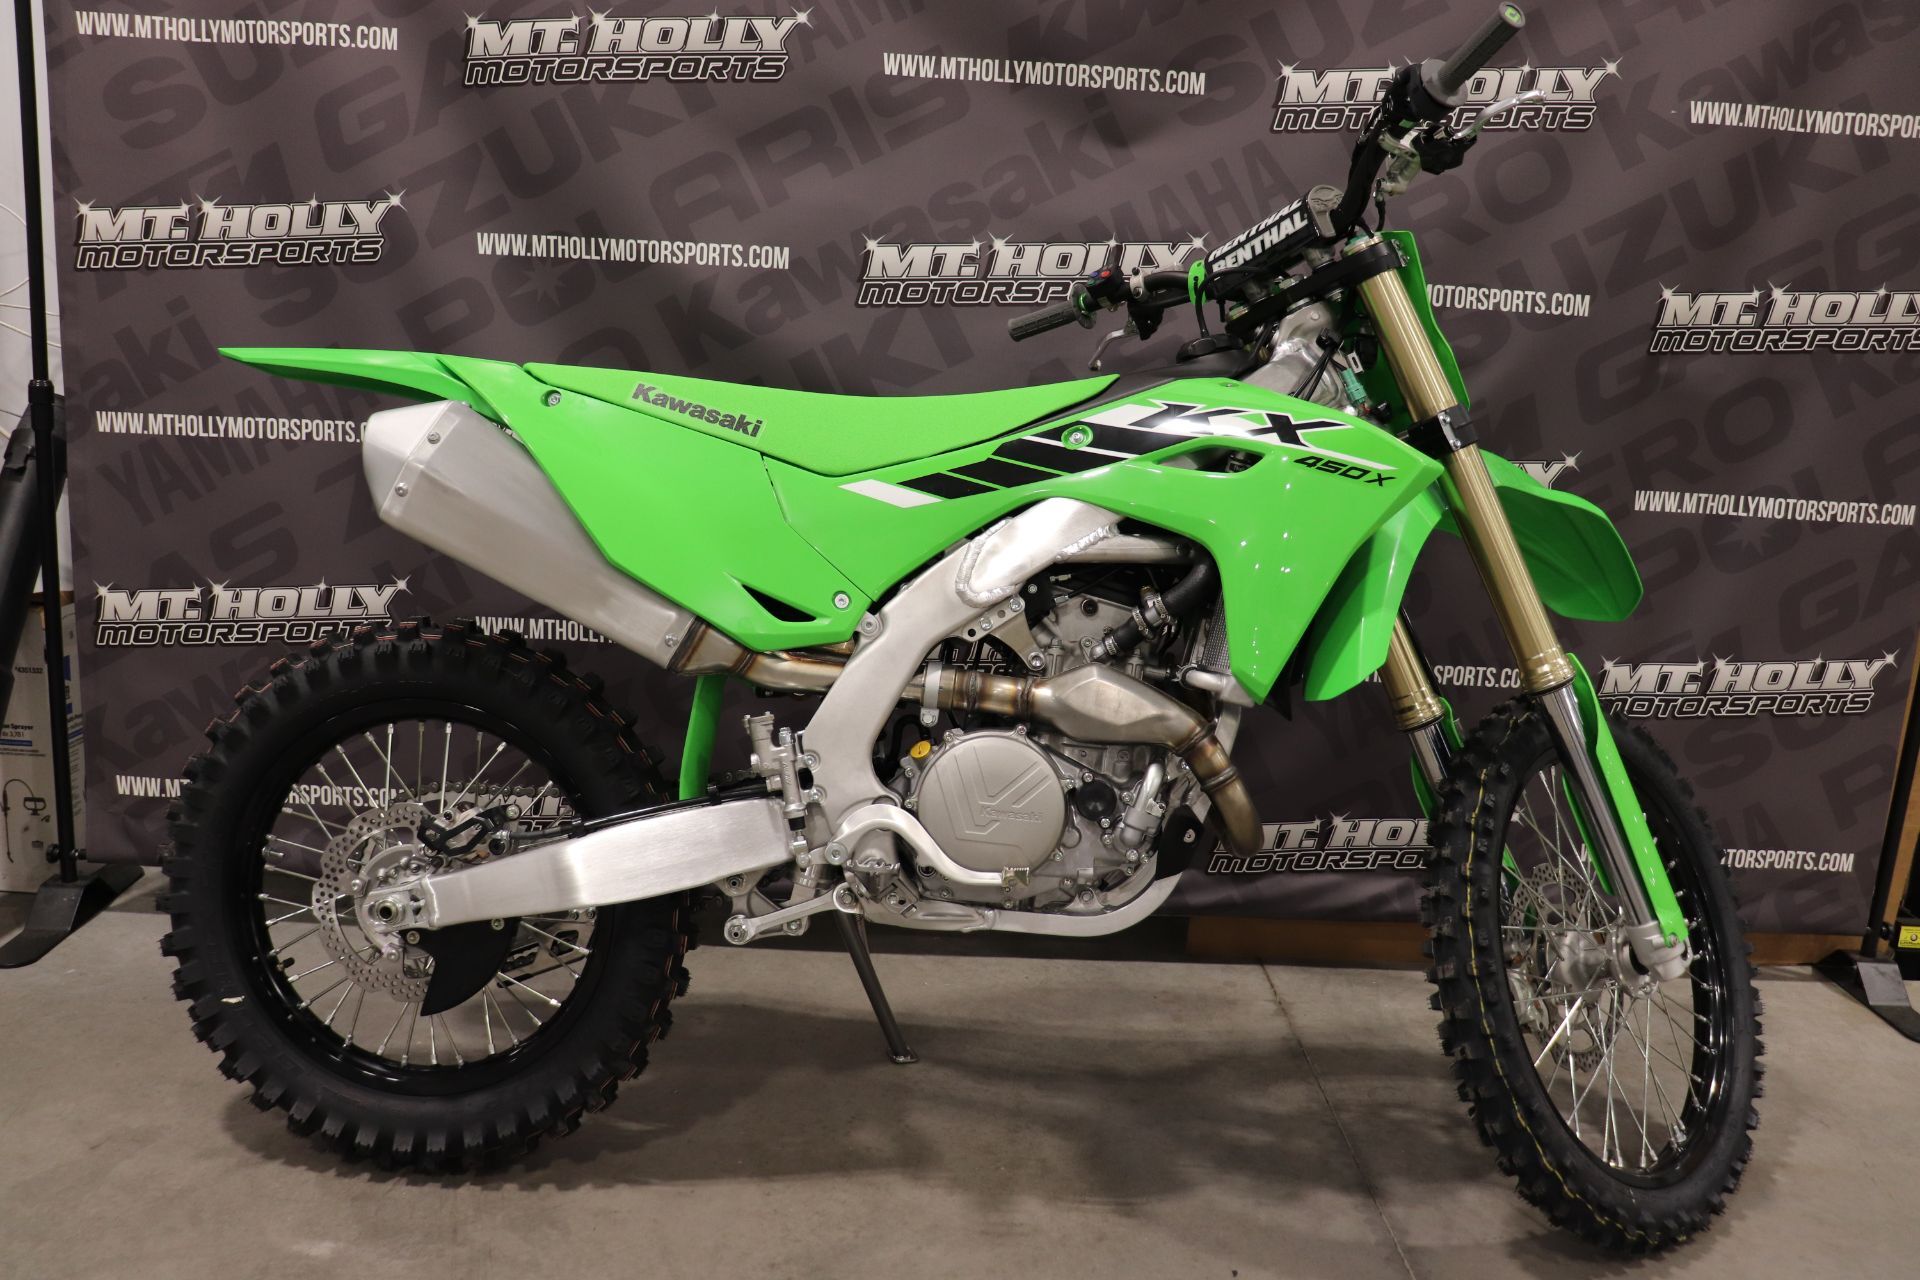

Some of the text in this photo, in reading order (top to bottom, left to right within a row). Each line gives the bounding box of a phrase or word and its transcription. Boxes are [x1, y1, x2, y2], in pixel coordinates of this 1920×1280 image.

[75, 10, 398, 51] WWW.MTHOLLYMOTORSPORTS.COM
[468, 19, 578, 58] MT.
[588, 17, 798, 55] HOLLY
[465, 56, 788, 86] MOTORSPORTS
[882, 52, 1206, 96] WWW.MTHOLLYMOTORSPORTS.COM
[1690, 100, 1920, 139] WWW.MTHOLLYMOTORSPOR
[80, 201, 395, 243] MT. HOLLY
[77, 239, 384, 269] MOTORSPORTS
[476, 231, 790, 271] WWW.MTHOLLYMOTORSPORTS.COM
[1212, 211, 1309, 273] RENTHAL
[863, 242, 979, 279] MT.
[858, 281, 1076, 304] MOTORSP
[1426, 284, 1591, 318] MOTORSPORTS.COM
[1657, 292, 1920, 327] MT. HOLL
[96, 410, 367, 443] WWW.MTHOLLYMOTORSPORTS.
[631, 383, 763, 439] Kawasaki
[1126, 401, 1348, 448] KX
[1293, 455, 1398, 487] 450X
[1634, 490, 1916, 526] WWW.MTHOLLYMOTORSPORTS.COM
[98, 585, 398, 622] MT. HOLLY
[1599, 658, 1886, 694] MT. HOLLY
[980, 805, 1044, 824] Kawasaki
[1208, 850, 1428, 873] MOTORSPO
